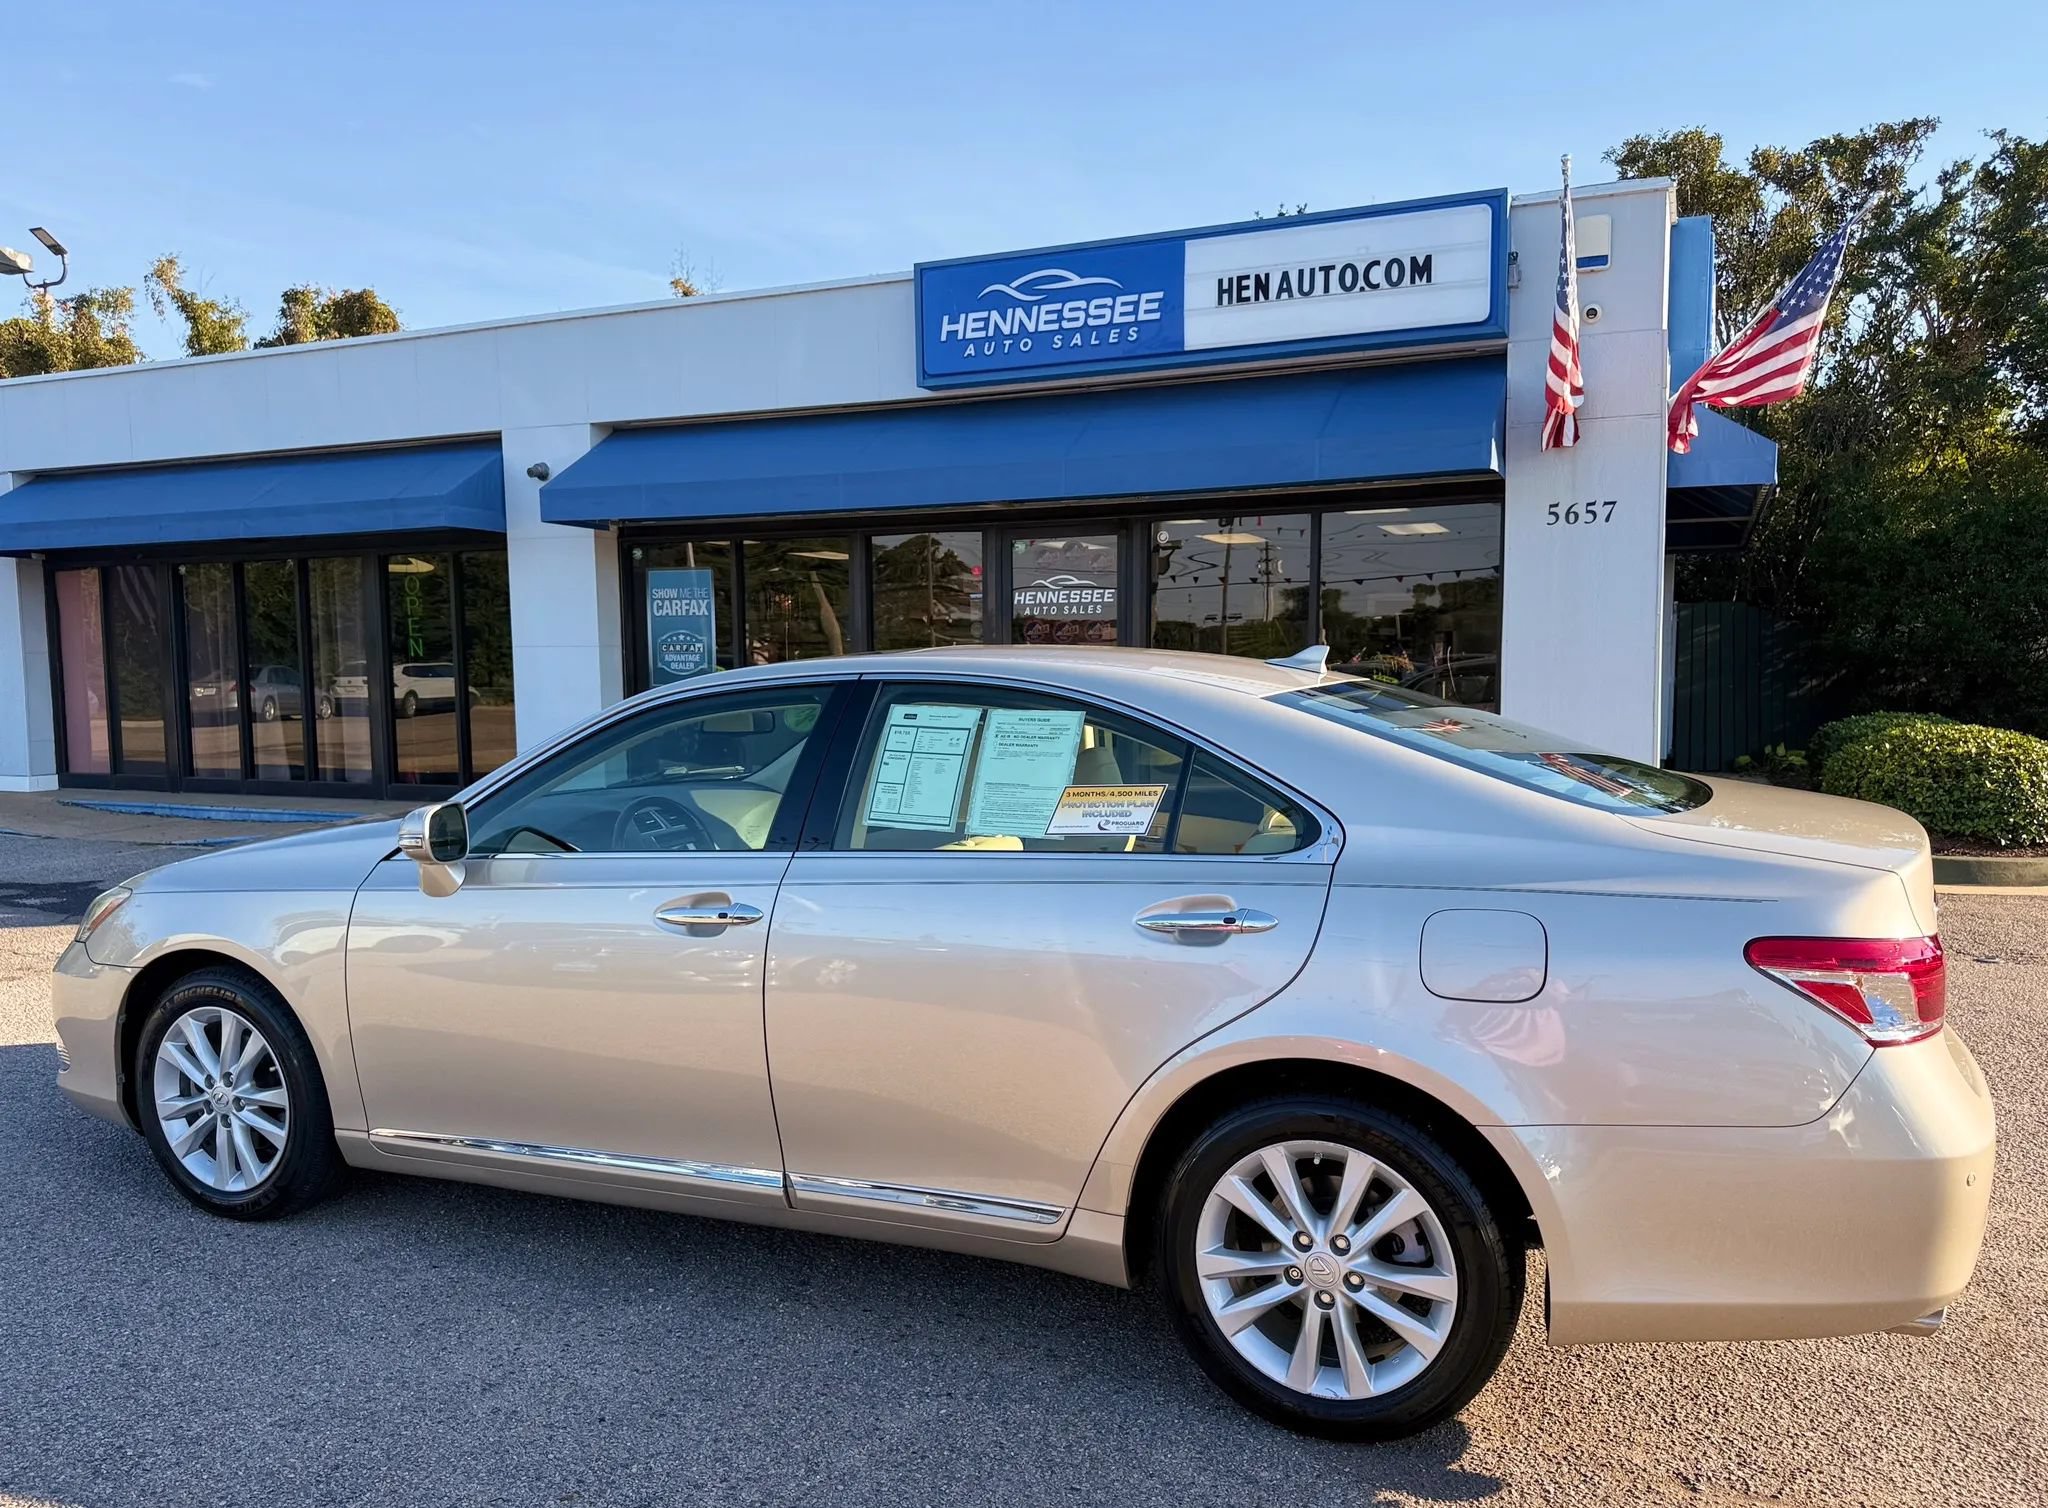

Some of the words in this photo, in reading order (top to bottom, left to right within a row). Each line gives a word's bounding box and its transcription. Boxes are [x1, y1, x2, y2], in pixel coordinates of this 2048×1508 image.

[1217, 254, 1433, 306] HENAUTO.COM
[940, 291, 1164, 342] HENNESSEE
[963, 338, 1033, 358] AUTO
[1052, 327, 1138, 349] SALES
[1546, 500, 1618, 526] 5657
[652, 588, 678, 599] SHOW
[680, 588, 694, 598] ME
[694, 588, 709, 598] THE
[1014, 589, 1115, 605] HENNESSEE
[653, 599, 709, 616] CARFAX
[1024, 606, 1057, 616] AUTO
[1063, 604, 1103, 615] SALES
[404, 575, 424, 657] OPEN
[664, 653, 700, 662] ADVANTAGE
[670, 661, 695, 670] DEALER
[1072, 790, 1133, 798] MONTHS/4,500
[1061, 801, 1125, 809] PROTECTION
[1082, 810, 1132, 818] INCLUDED
[174, 986, 236, 1004] MICHELIN
